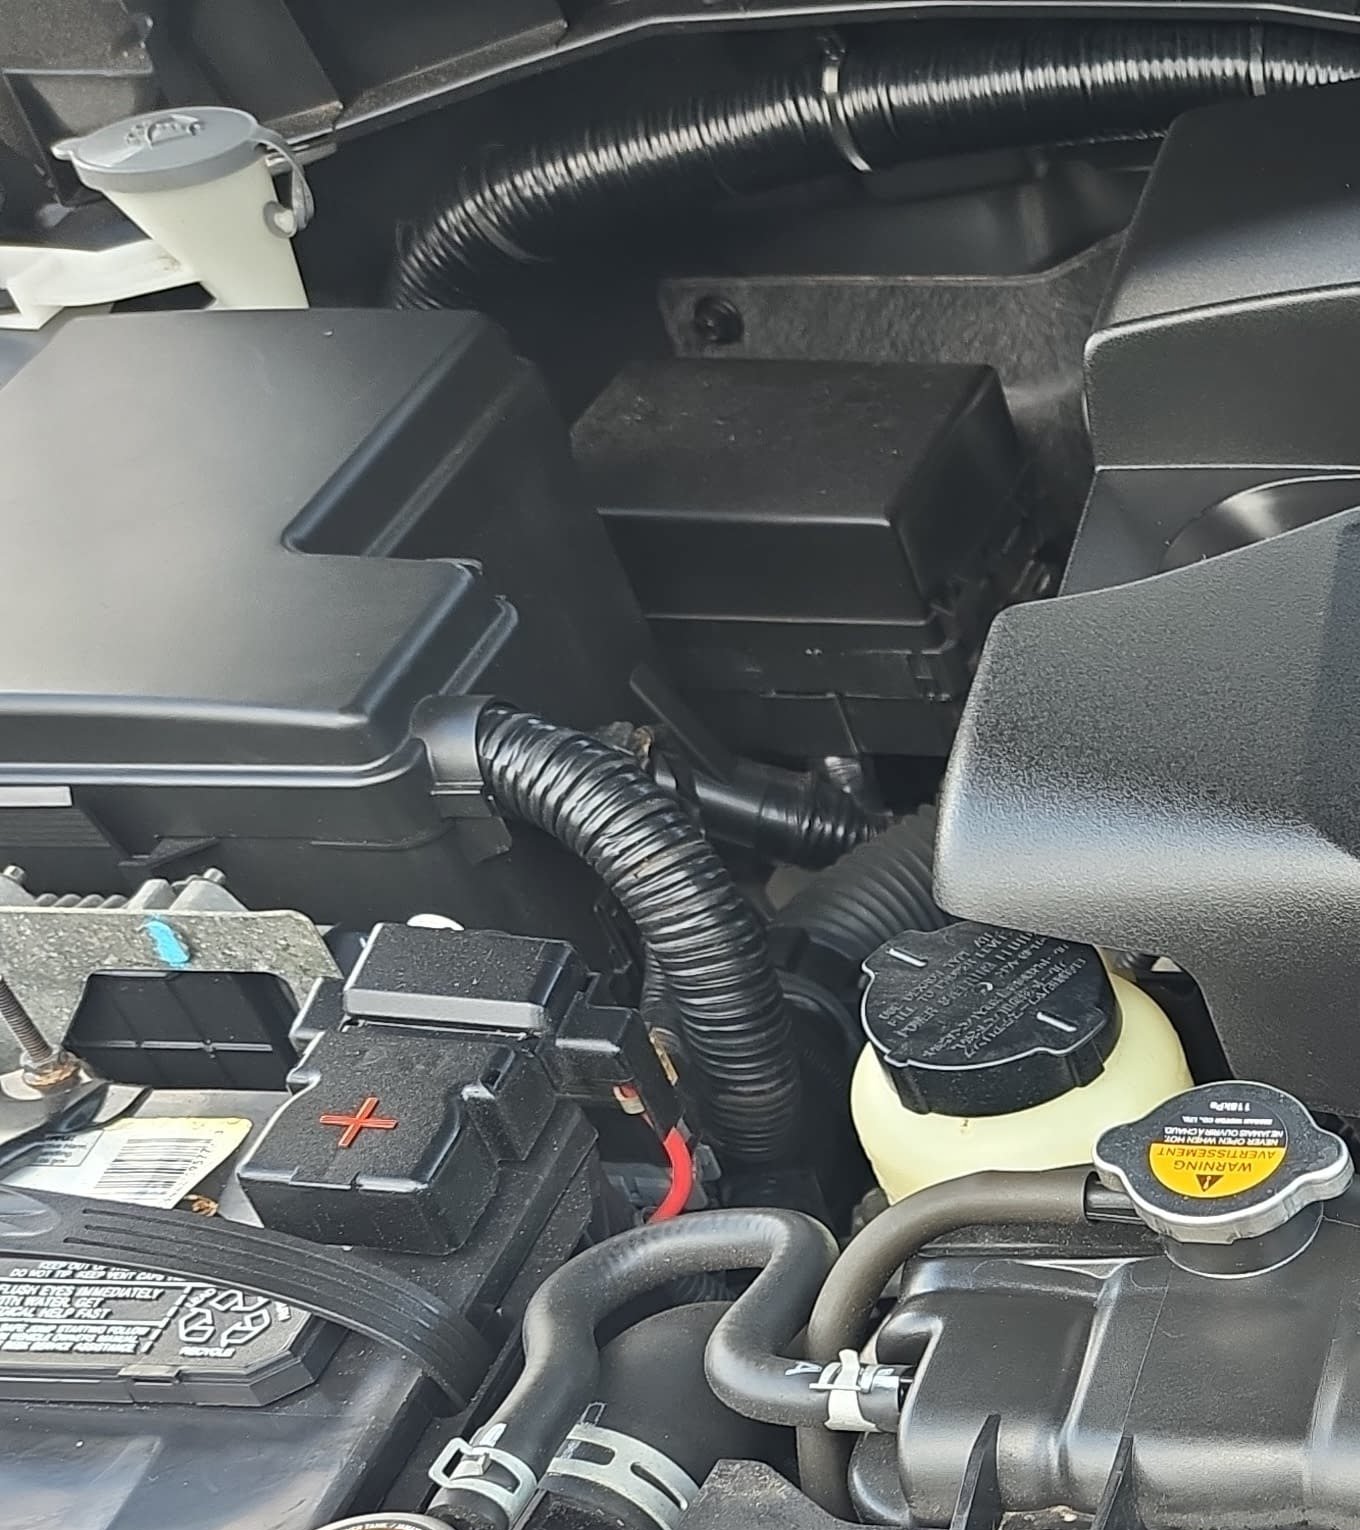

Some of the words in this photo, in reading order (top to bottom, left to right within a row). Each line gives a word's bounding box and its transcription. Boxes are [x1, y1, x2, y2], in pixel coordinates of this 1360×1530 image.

[1205, 1128, 1239, 1137] OUVRIR
[1187, 1136, 1217, 1145] WHEN
[1218, 1137, 1246, 1146] OPEN
[1247, 1138, 1279, 1146] NEVER
[1158, 1147, 1276, 1159] AVERTISSEMENT
[1174, 1160, 1252, 1172] WARNING
[10, 1268, 27, 1277] DO
[28, 1269, 52, 1278] NOT
[106, 1271, 137, 1280] VENT
[39, 1285, 76, 1296] EYES
[75, 1286, 164, 1299] IMMEDIATELY
[73, 1298, 104, 1308] GET
[38, 1307, 75, 1318] HELP
[75, 1309, 112, 1319] FAST
